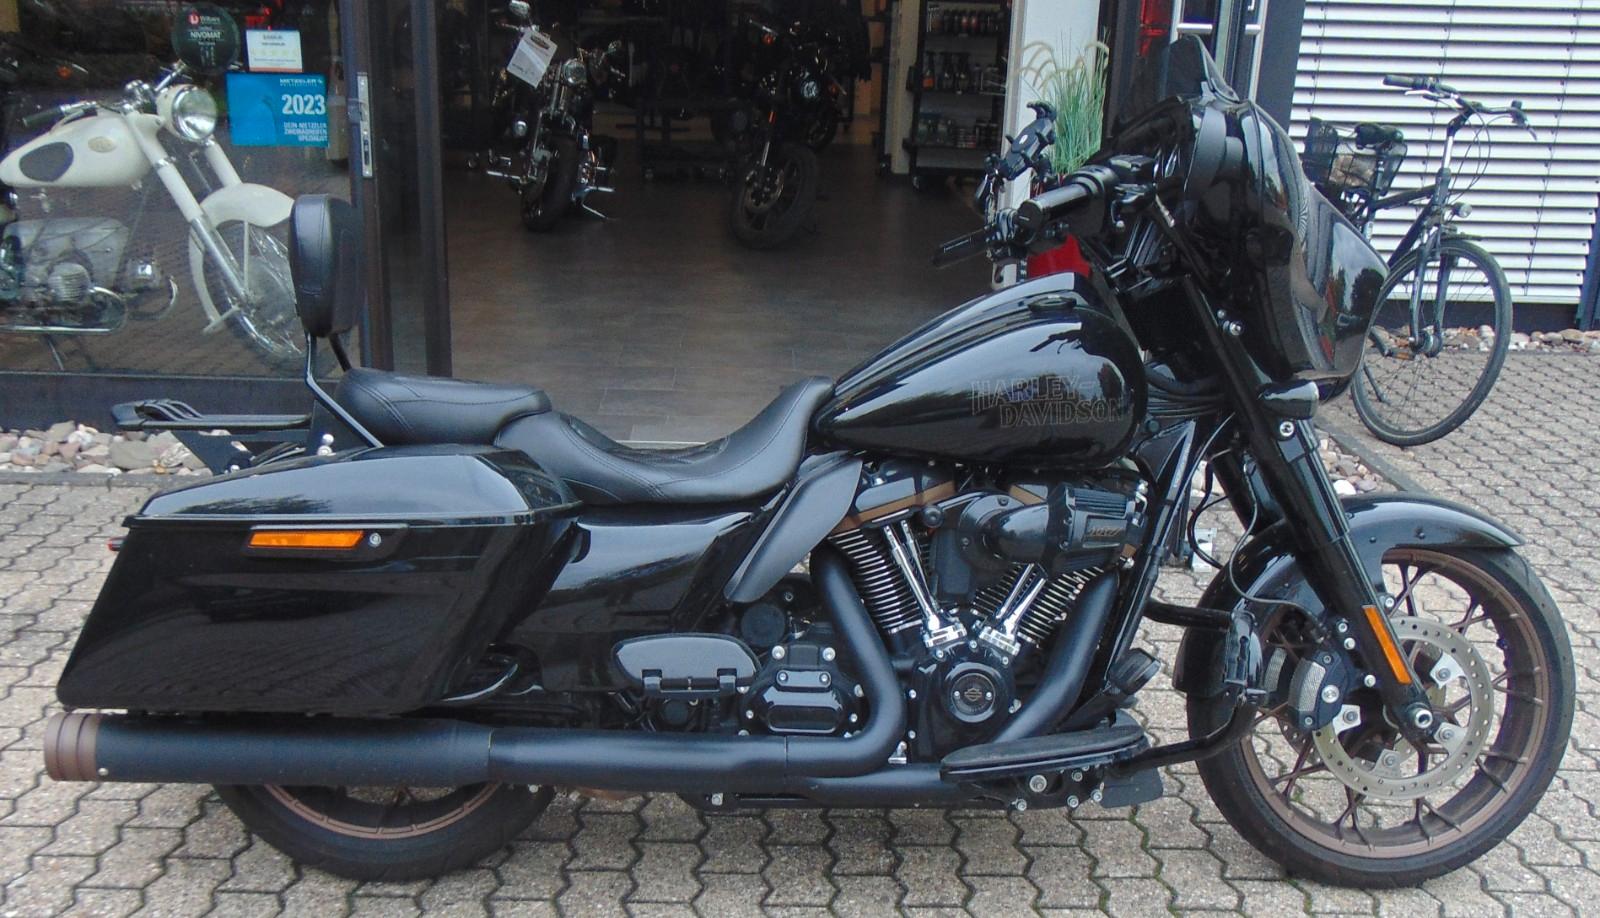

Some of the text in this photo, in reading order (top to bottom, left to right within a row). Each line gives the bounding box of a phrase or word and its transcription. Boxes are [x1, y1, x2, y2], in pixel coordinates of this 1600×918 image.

[190, 31, 221, 39] NIVOMAT
[281, 94, 326, 115] 2023
[1000, 399, 1123, 428] DAVIDSON
